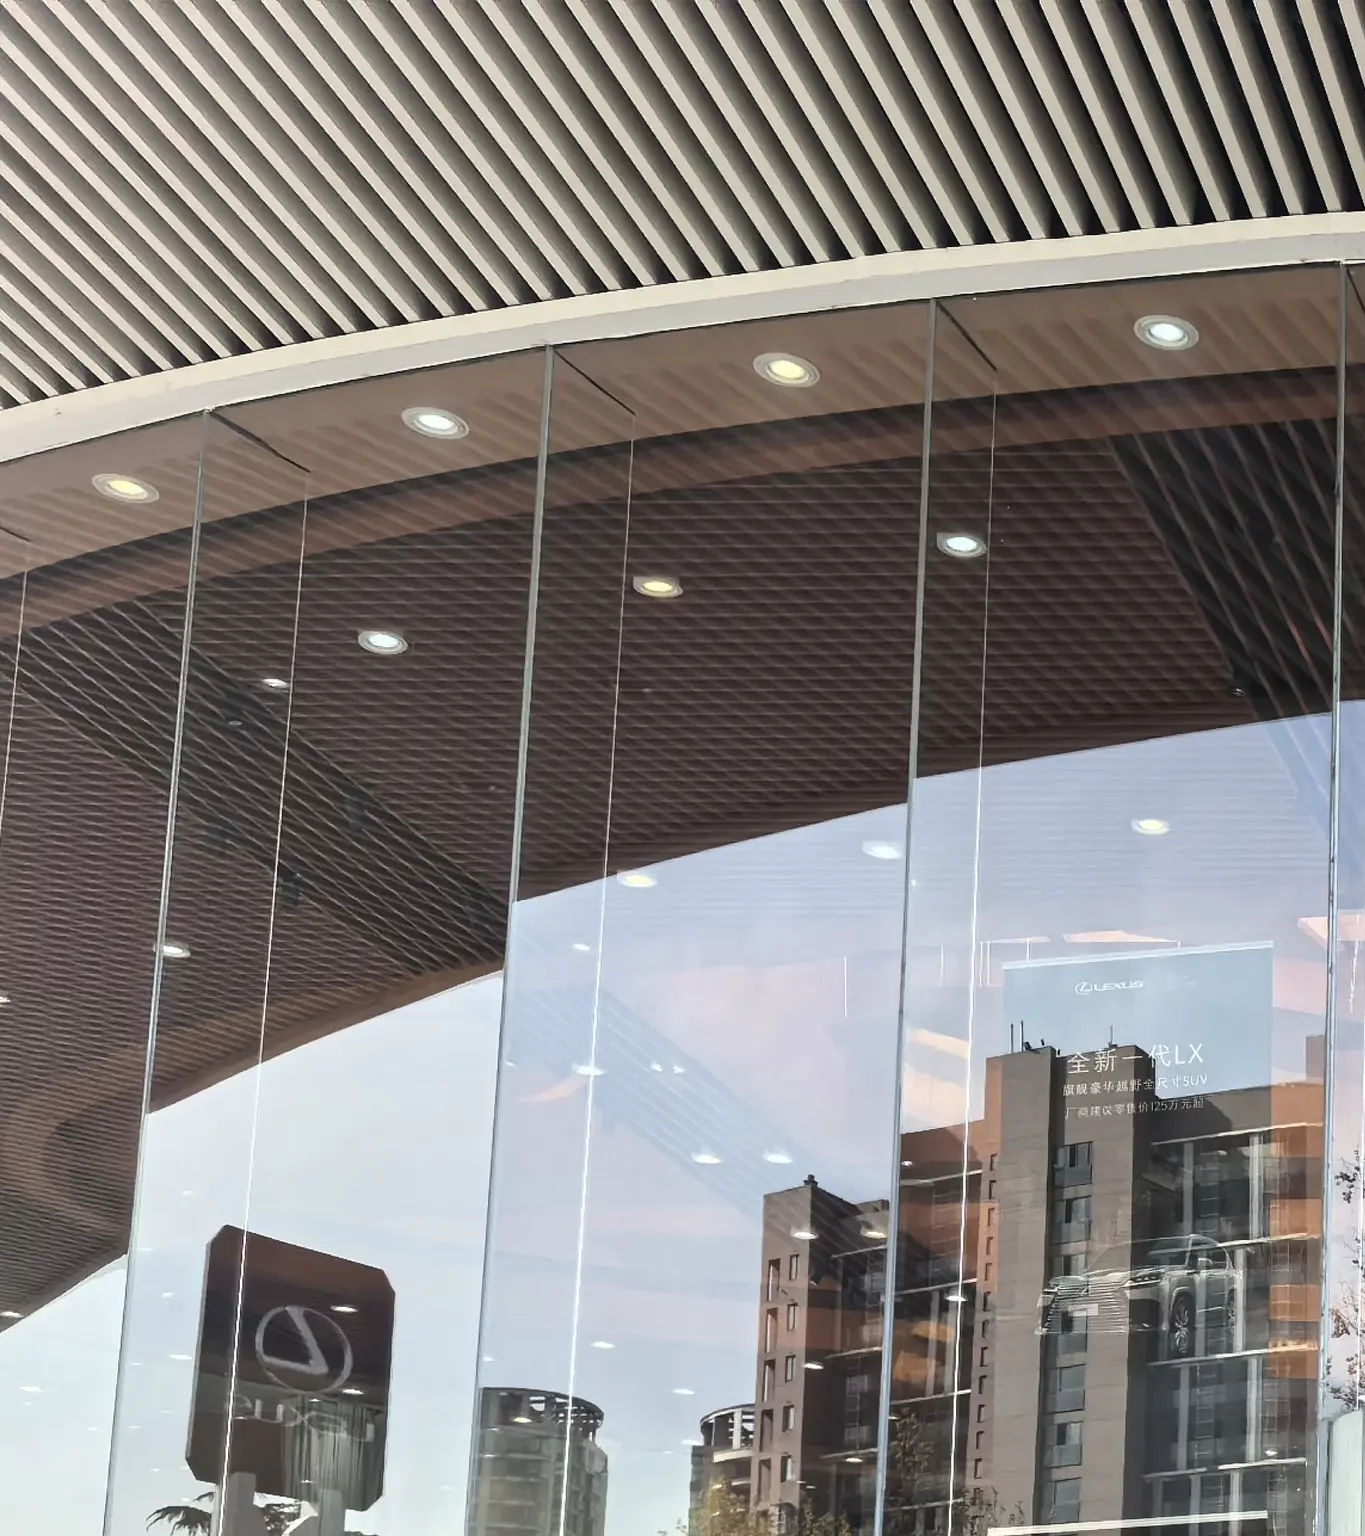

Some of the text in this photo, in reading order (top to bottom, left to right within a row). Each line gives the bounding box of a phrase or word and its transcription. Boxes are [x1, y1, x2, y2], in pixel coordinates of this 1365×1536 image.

[1094, 980, 1145, 992] LEXUS
[1067, 1042, 1204, 1074] 全新一代LX
[1063, 1074, 1208, 1097] 旗舰豪华越野全尺寸SUV
